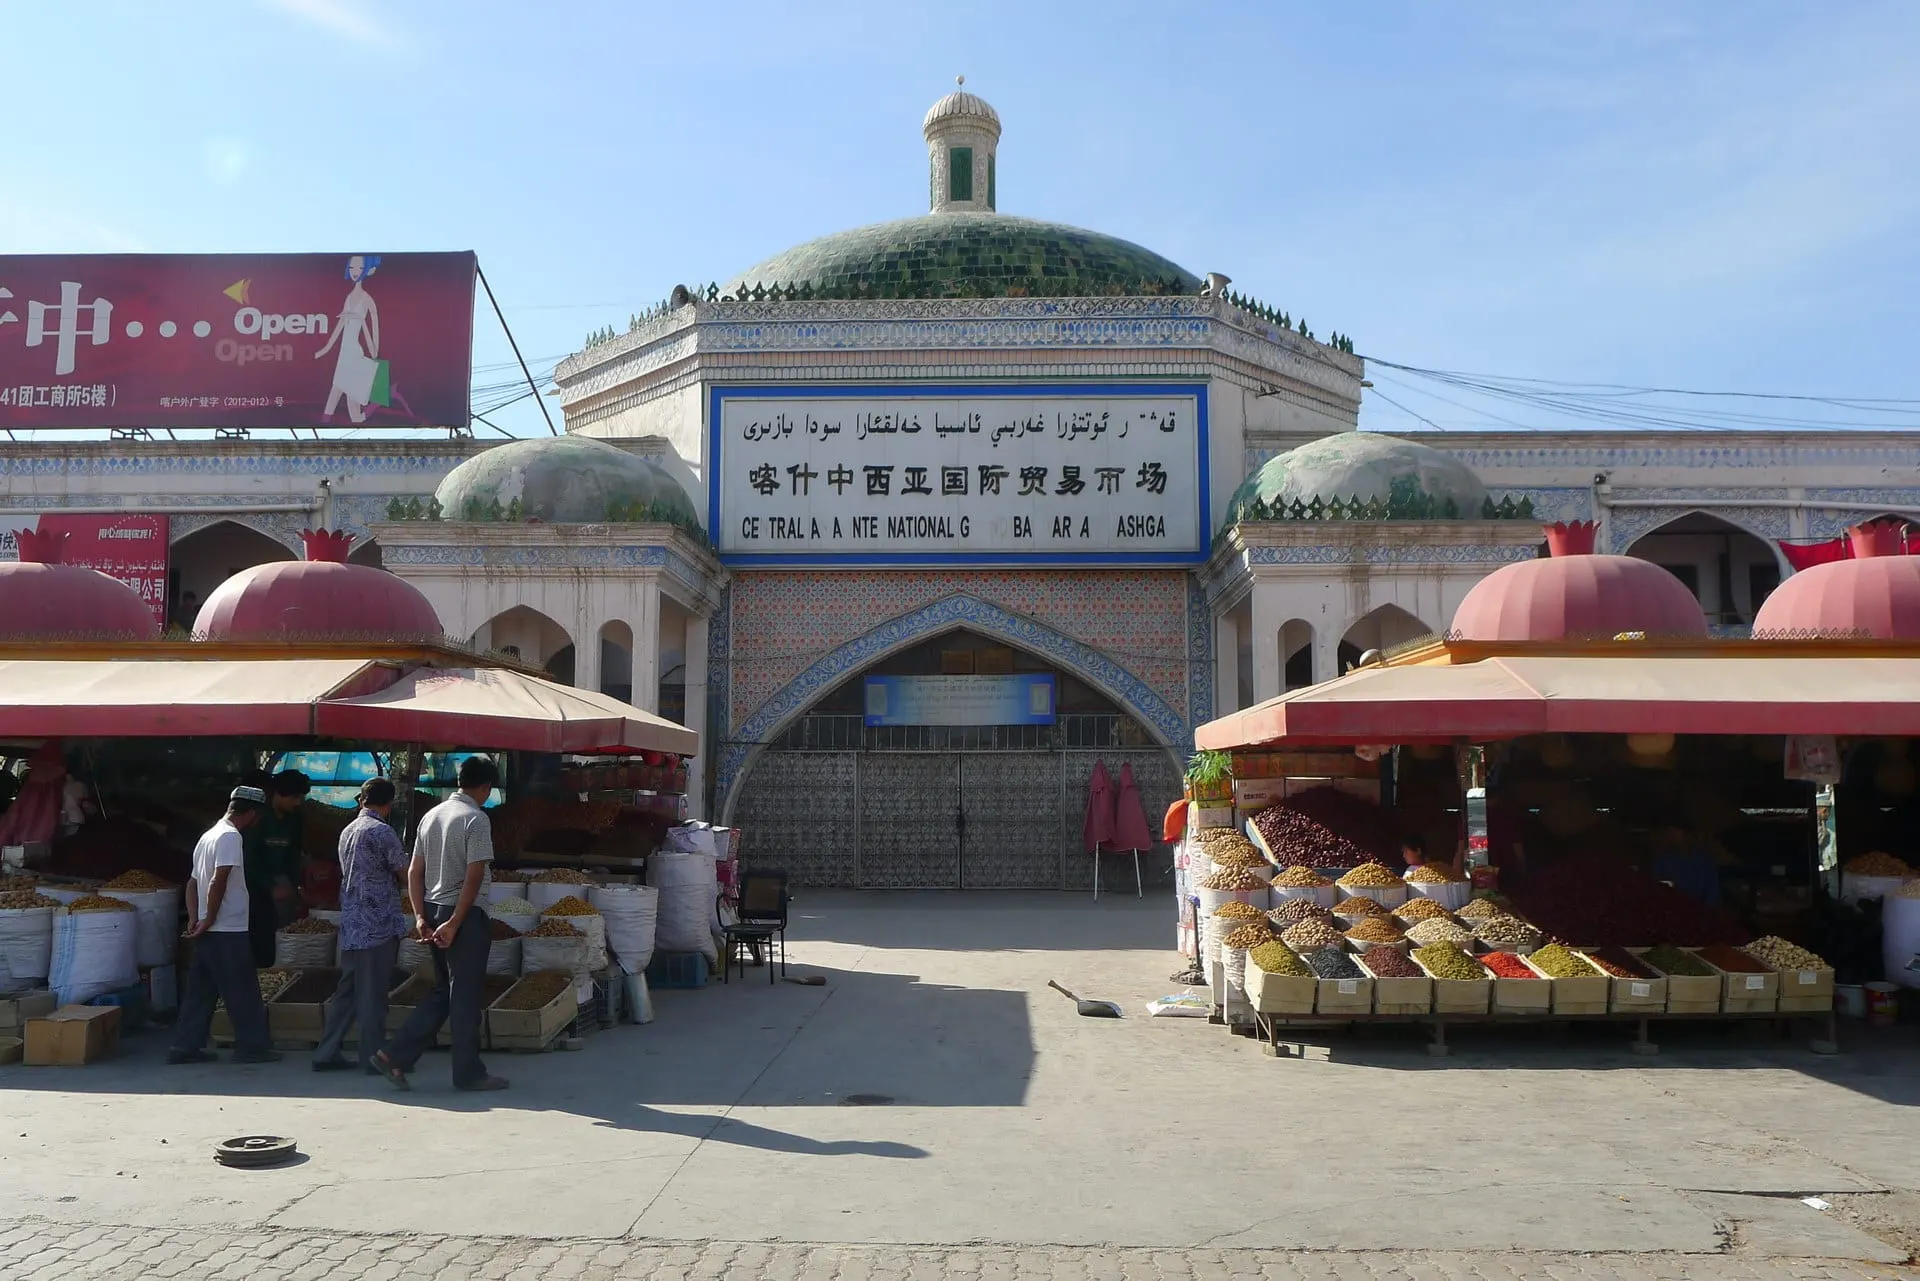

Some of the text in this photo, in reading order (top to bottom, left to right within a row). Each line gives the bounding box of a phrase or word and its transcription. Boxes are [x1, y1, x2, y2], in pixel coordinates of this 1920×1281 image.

[234, 307, 328, 340] Open
[215, 339, 292, 366] Open
[749, 461, 1168, 497] 喀什中西亚国际贸易市场
